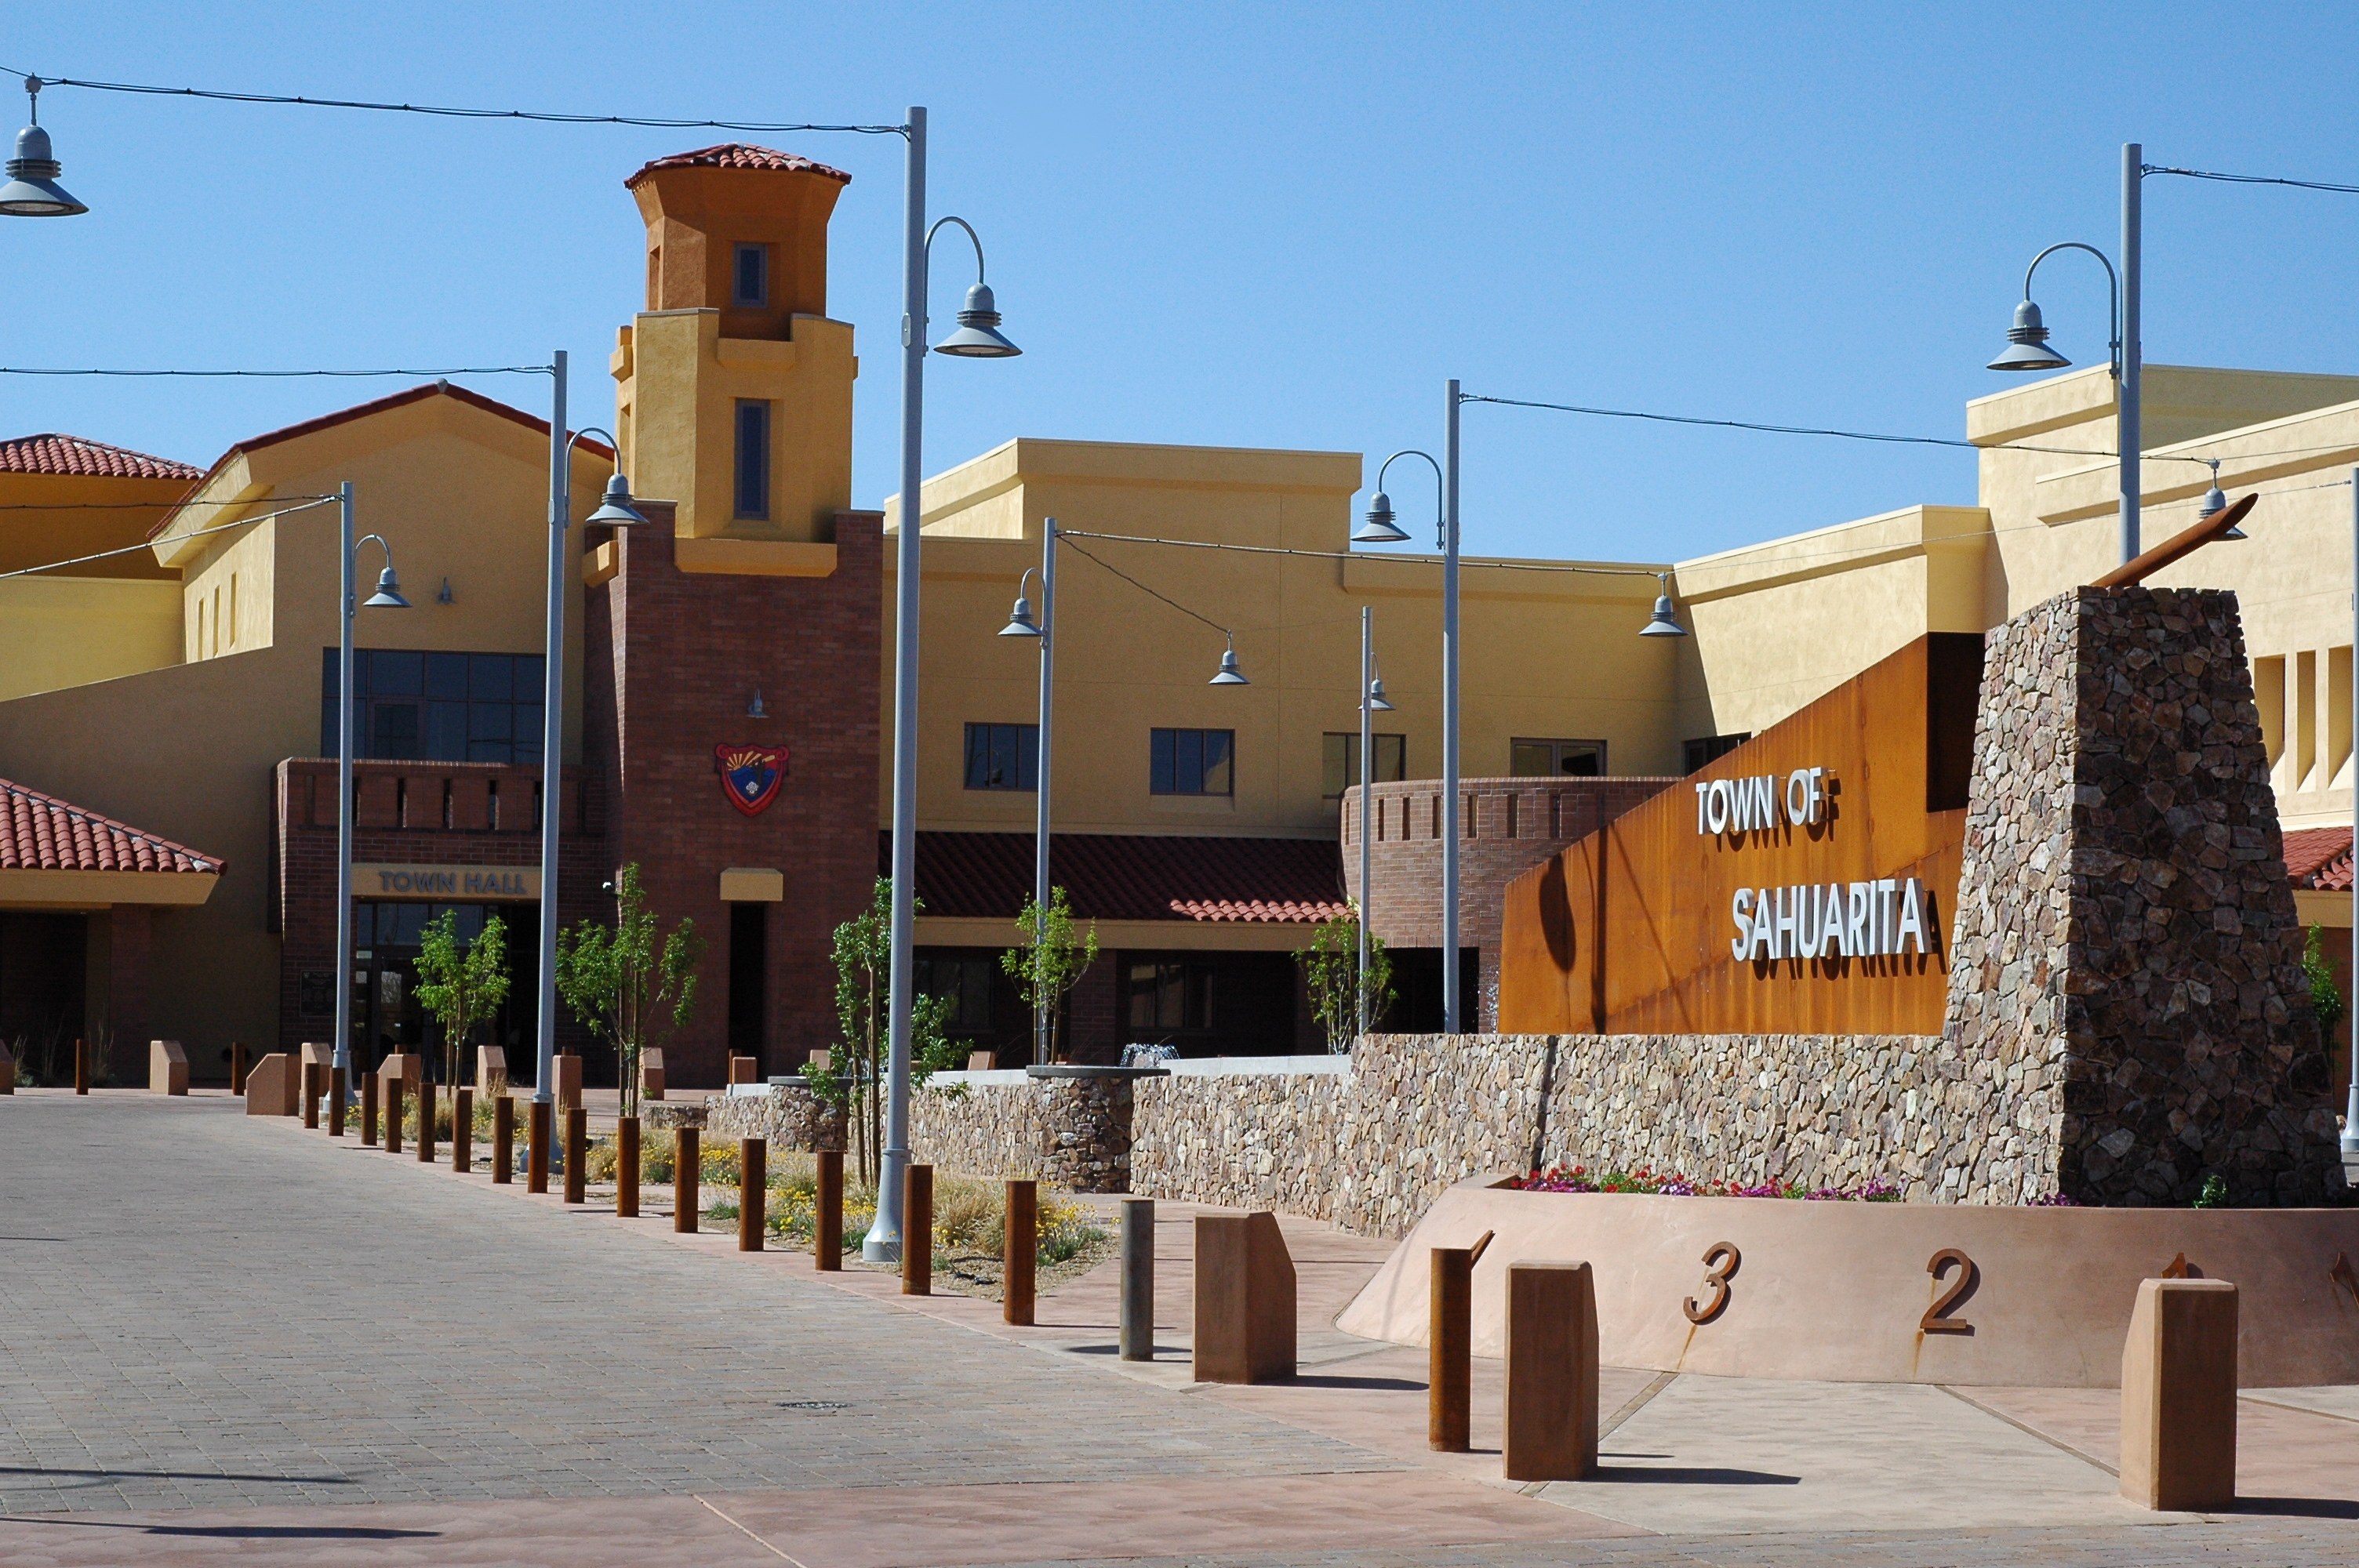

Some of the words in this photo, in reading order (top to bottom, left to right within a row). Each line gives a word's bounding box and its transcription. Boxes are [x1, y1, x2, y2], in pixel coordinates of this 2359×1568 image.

[1696, 774, 1777, 835] TOWN
[1787, 767, 1826, 826] OF
[380, 869, 456, 893] TOWN
[464, 872, 527, 895] HALL
[1732, 877, 1928, 962] SAHUARITA
[1682, 1241, 1739, 1322] 3
[1919, 1248, 1972, 1330] 2
